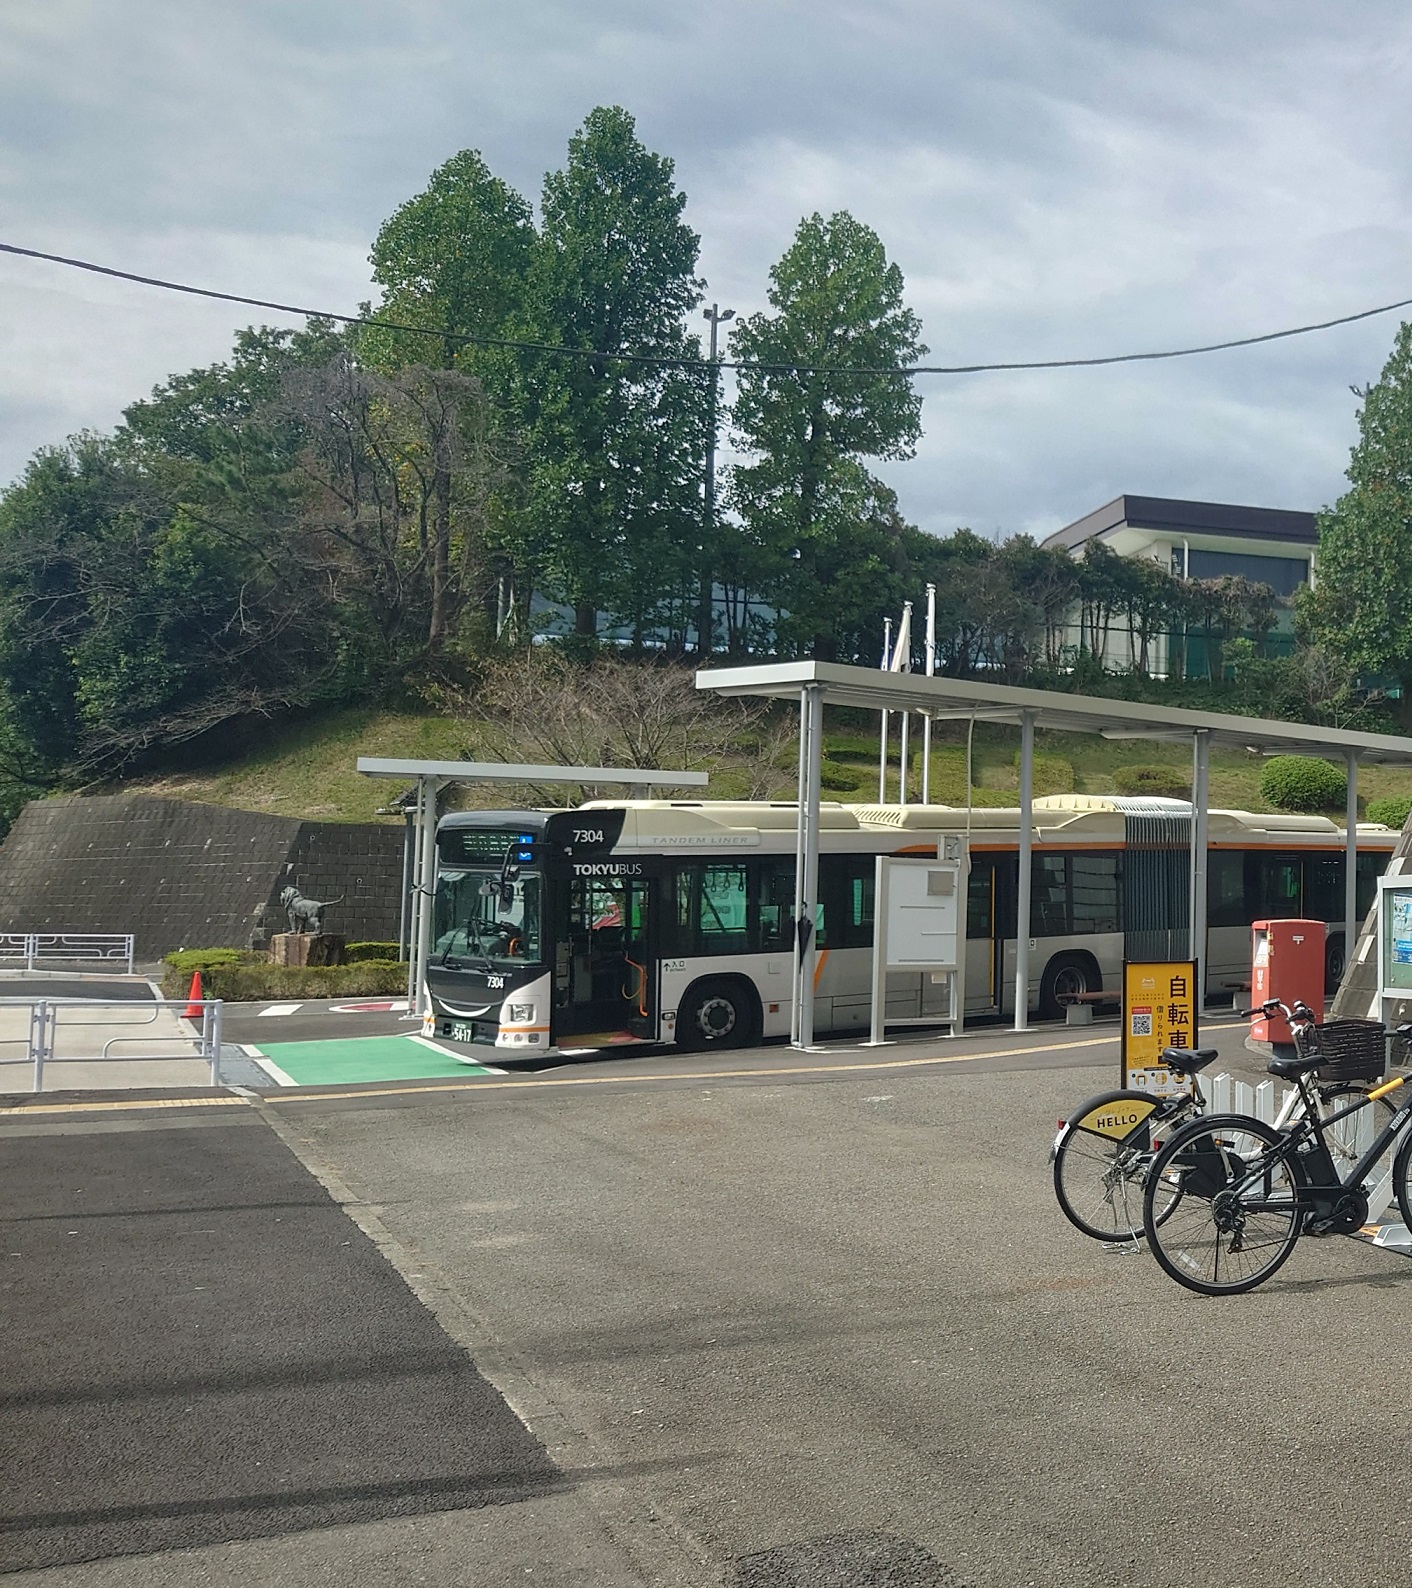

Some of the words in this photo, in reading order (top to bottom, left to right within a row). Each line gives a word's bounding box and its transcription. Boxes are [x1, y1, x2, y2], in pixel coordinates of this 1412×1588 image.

[573, 830, 604, 843] 7304
[487, 976, 504, 989] 7304
[1167, 975, 1190, 1049] 自転車
[1097, 1114, 1138, 1129] HELLO
